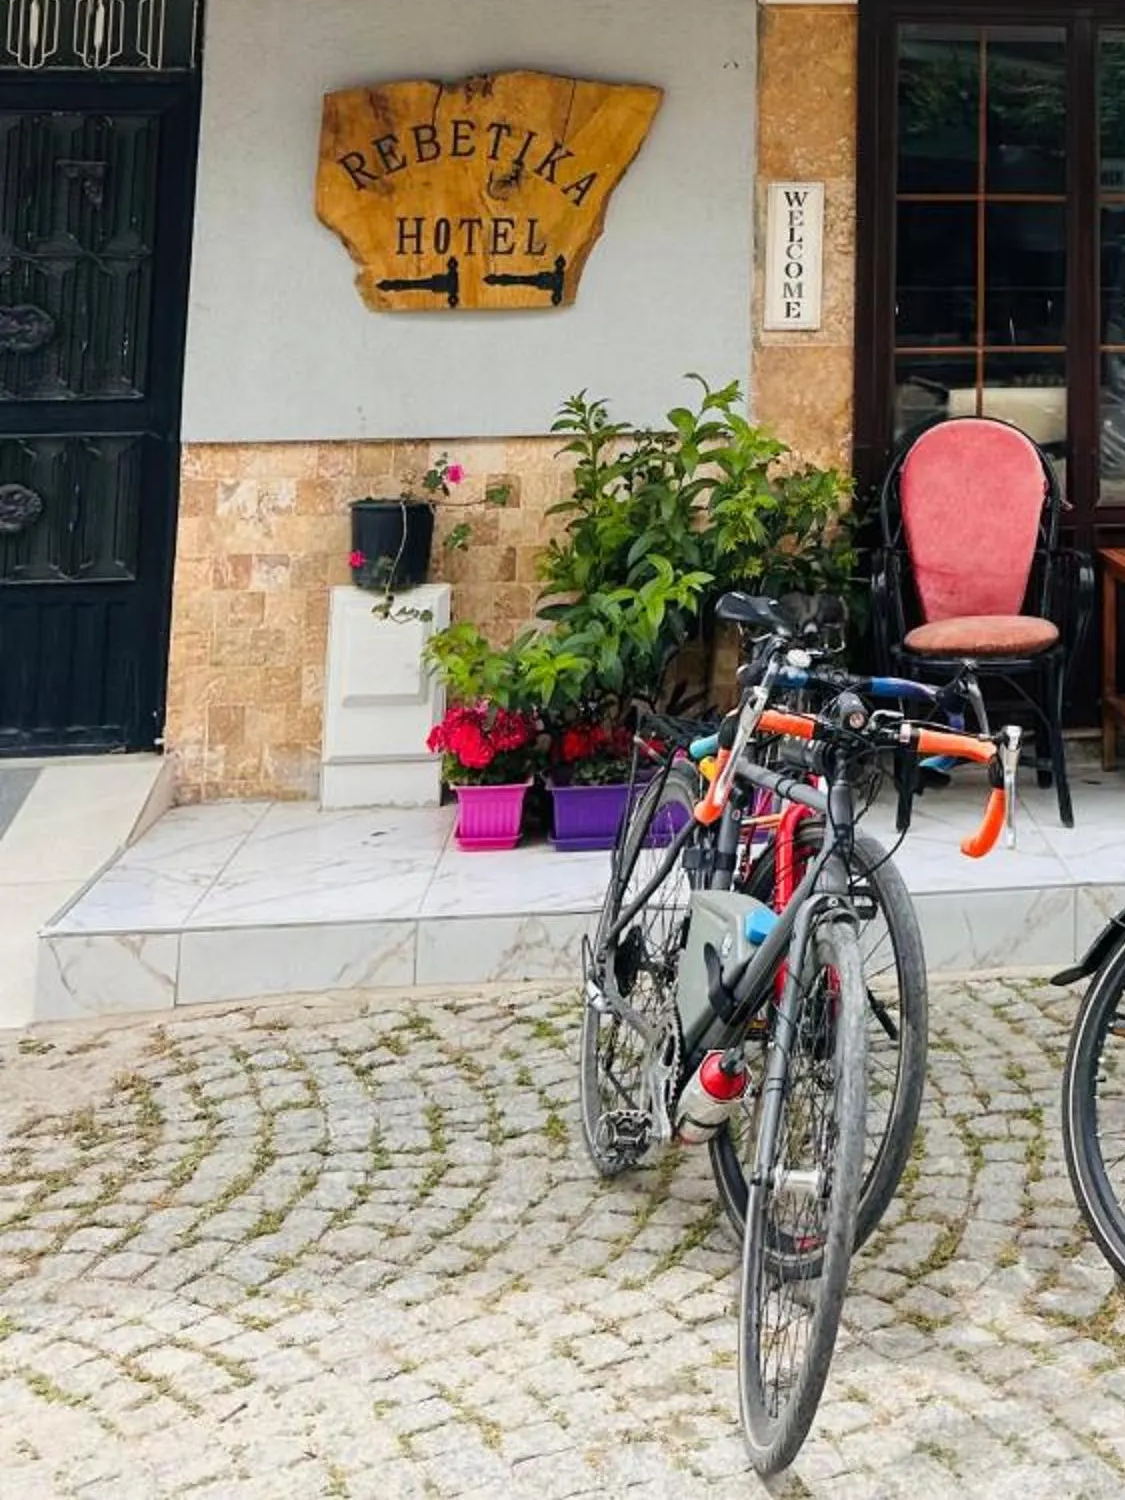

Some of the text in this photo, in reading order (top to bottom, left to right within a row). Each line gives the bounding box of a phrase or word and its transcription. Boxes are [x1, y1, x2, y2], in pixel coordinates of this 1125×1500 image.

[337, 119, 600, 207] REBETIKA
[394, 217, 548, 256] HOTEL
[783, 191, 809, 319] WELCOME
